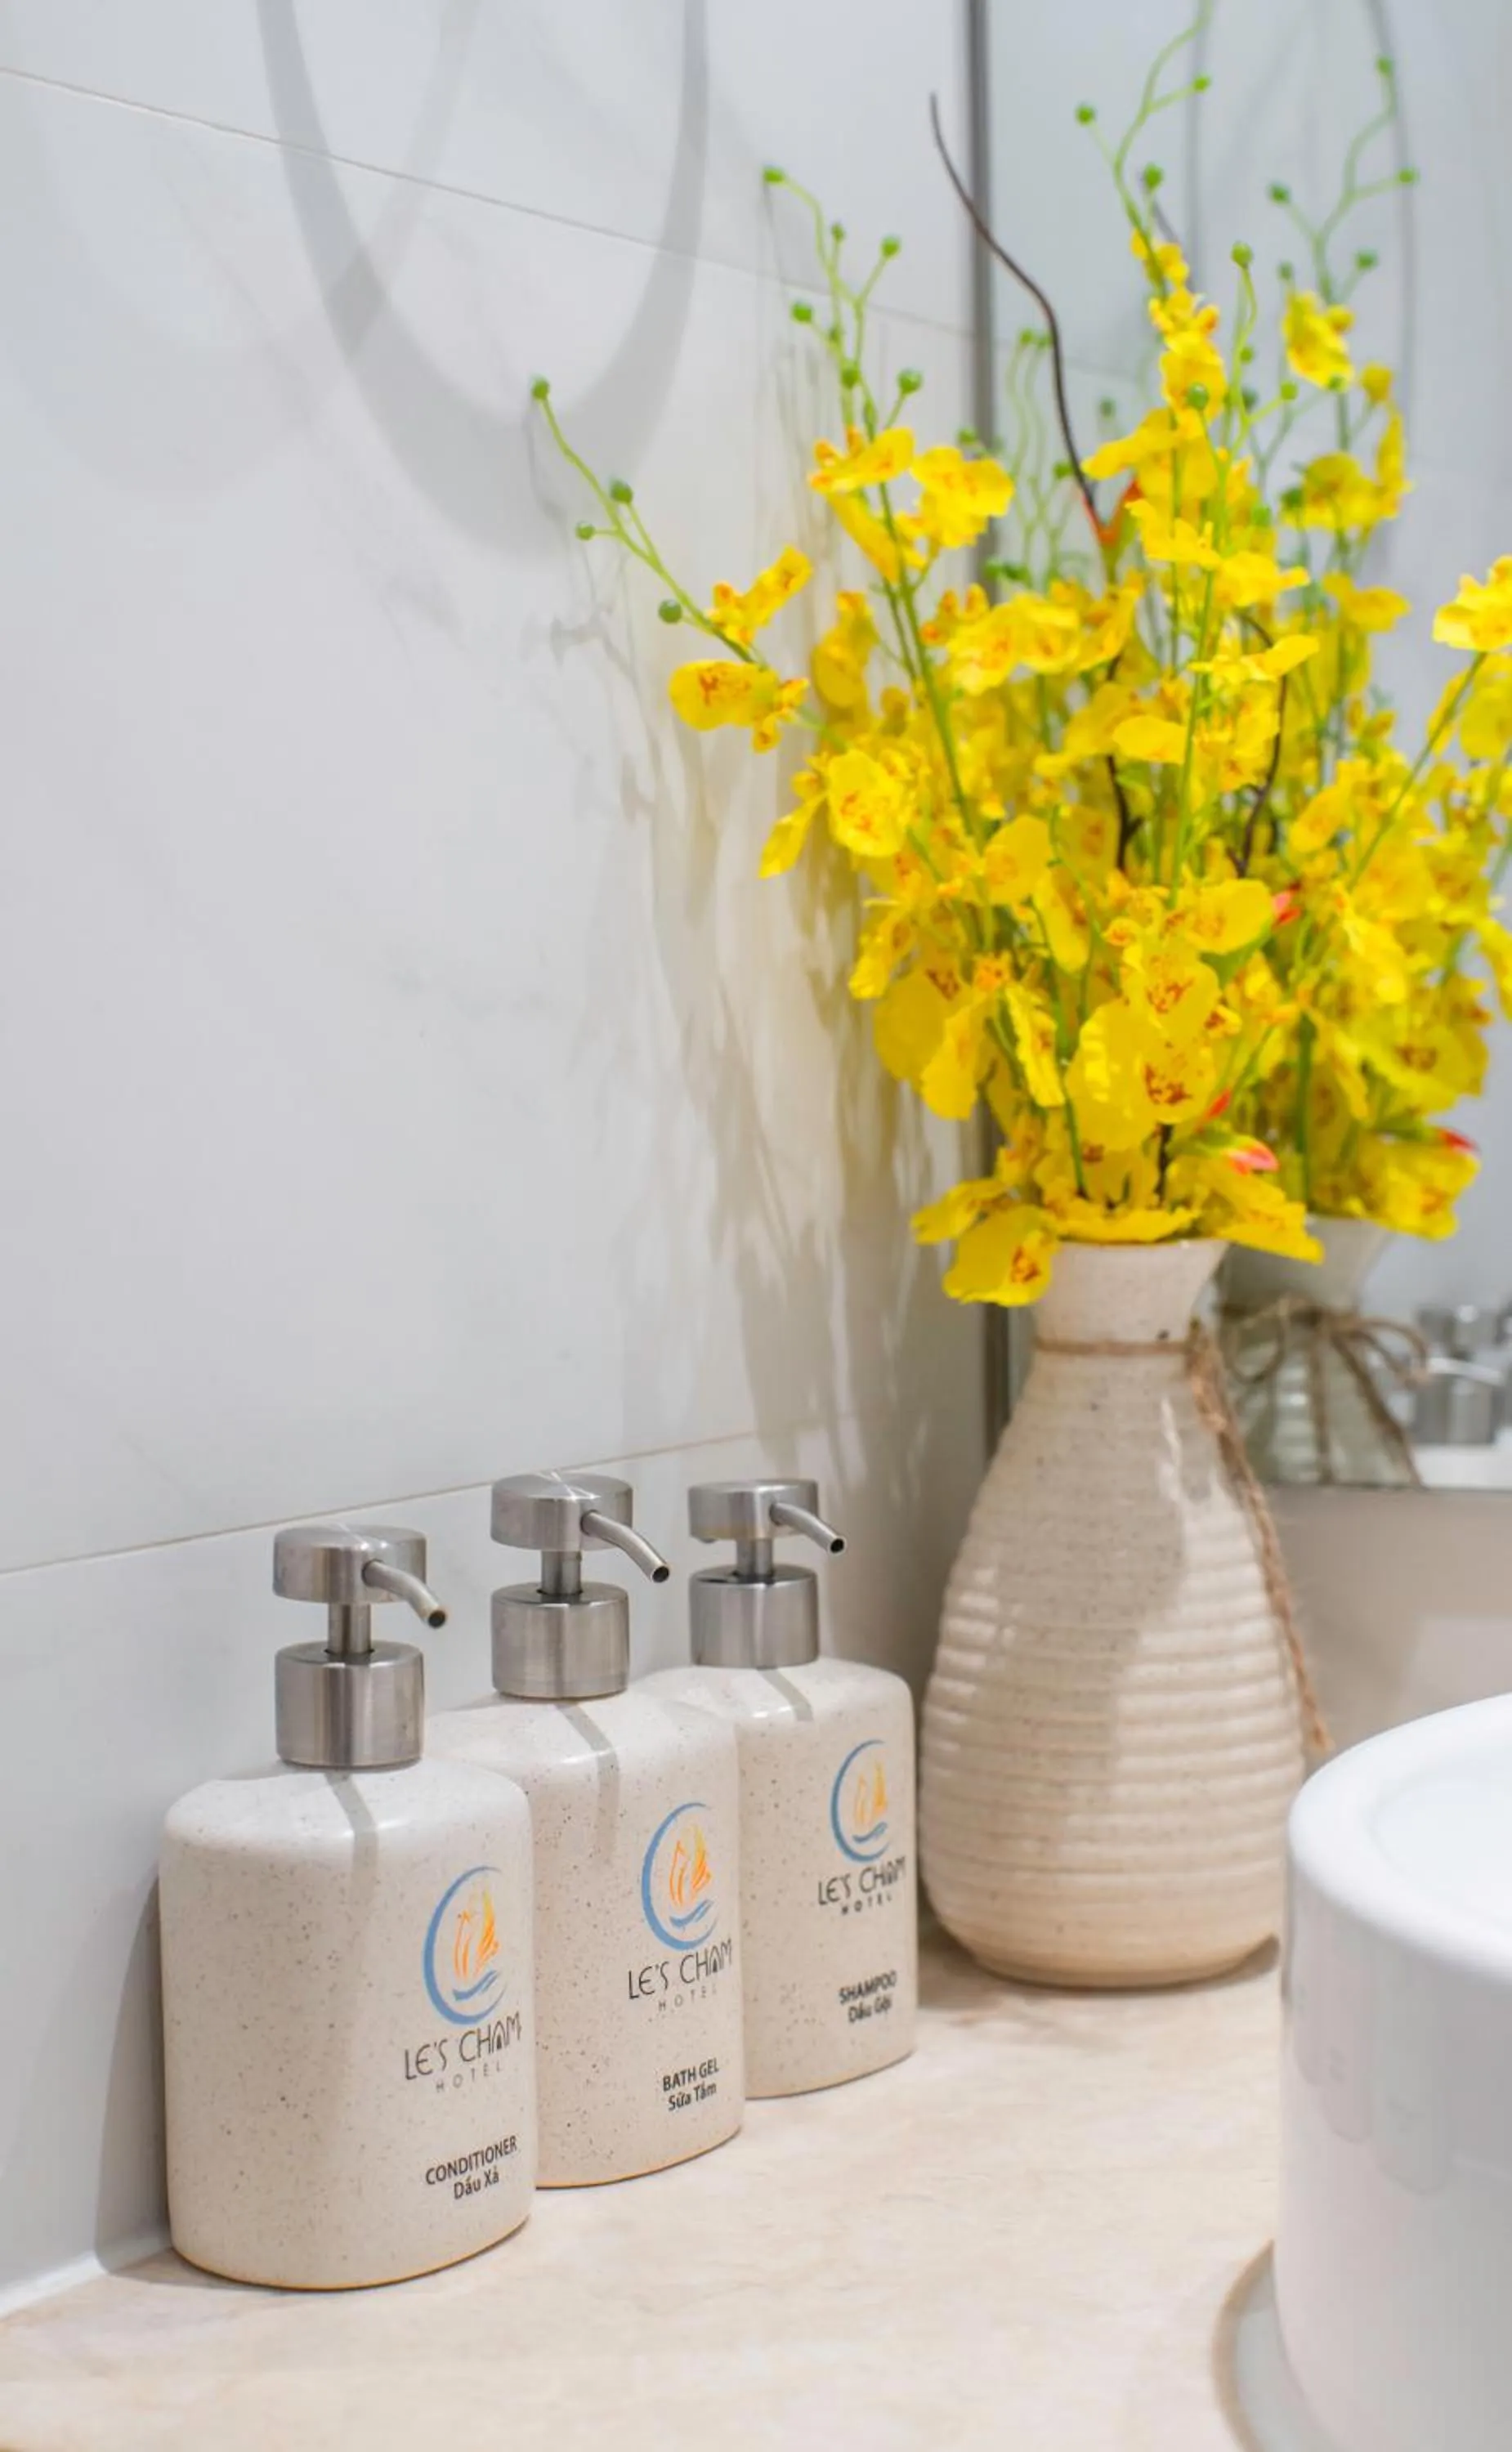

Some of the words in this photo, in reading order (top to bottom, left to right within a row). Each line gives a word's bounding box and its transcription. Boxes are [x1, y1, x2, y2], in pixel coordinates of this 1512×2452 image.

[628, 1961, 670, 2000] LE'S
[680, 1938, 733, 1984] CHAM
[658, 1987, 718, 2011] HOTEL
[839, 1970, 897, 2004] SHAMPOO
[404, 2038, 448, 2080] LE'S
[459, 2011, 522, 2062] CHAM
[436, 2063, 504, 2093] HOTEL
[662, 2066, 697, 2092] BATH
[698, 2057, 720, 2080] GEL
[425, 2135, 518, 2186] CONDITIONER
